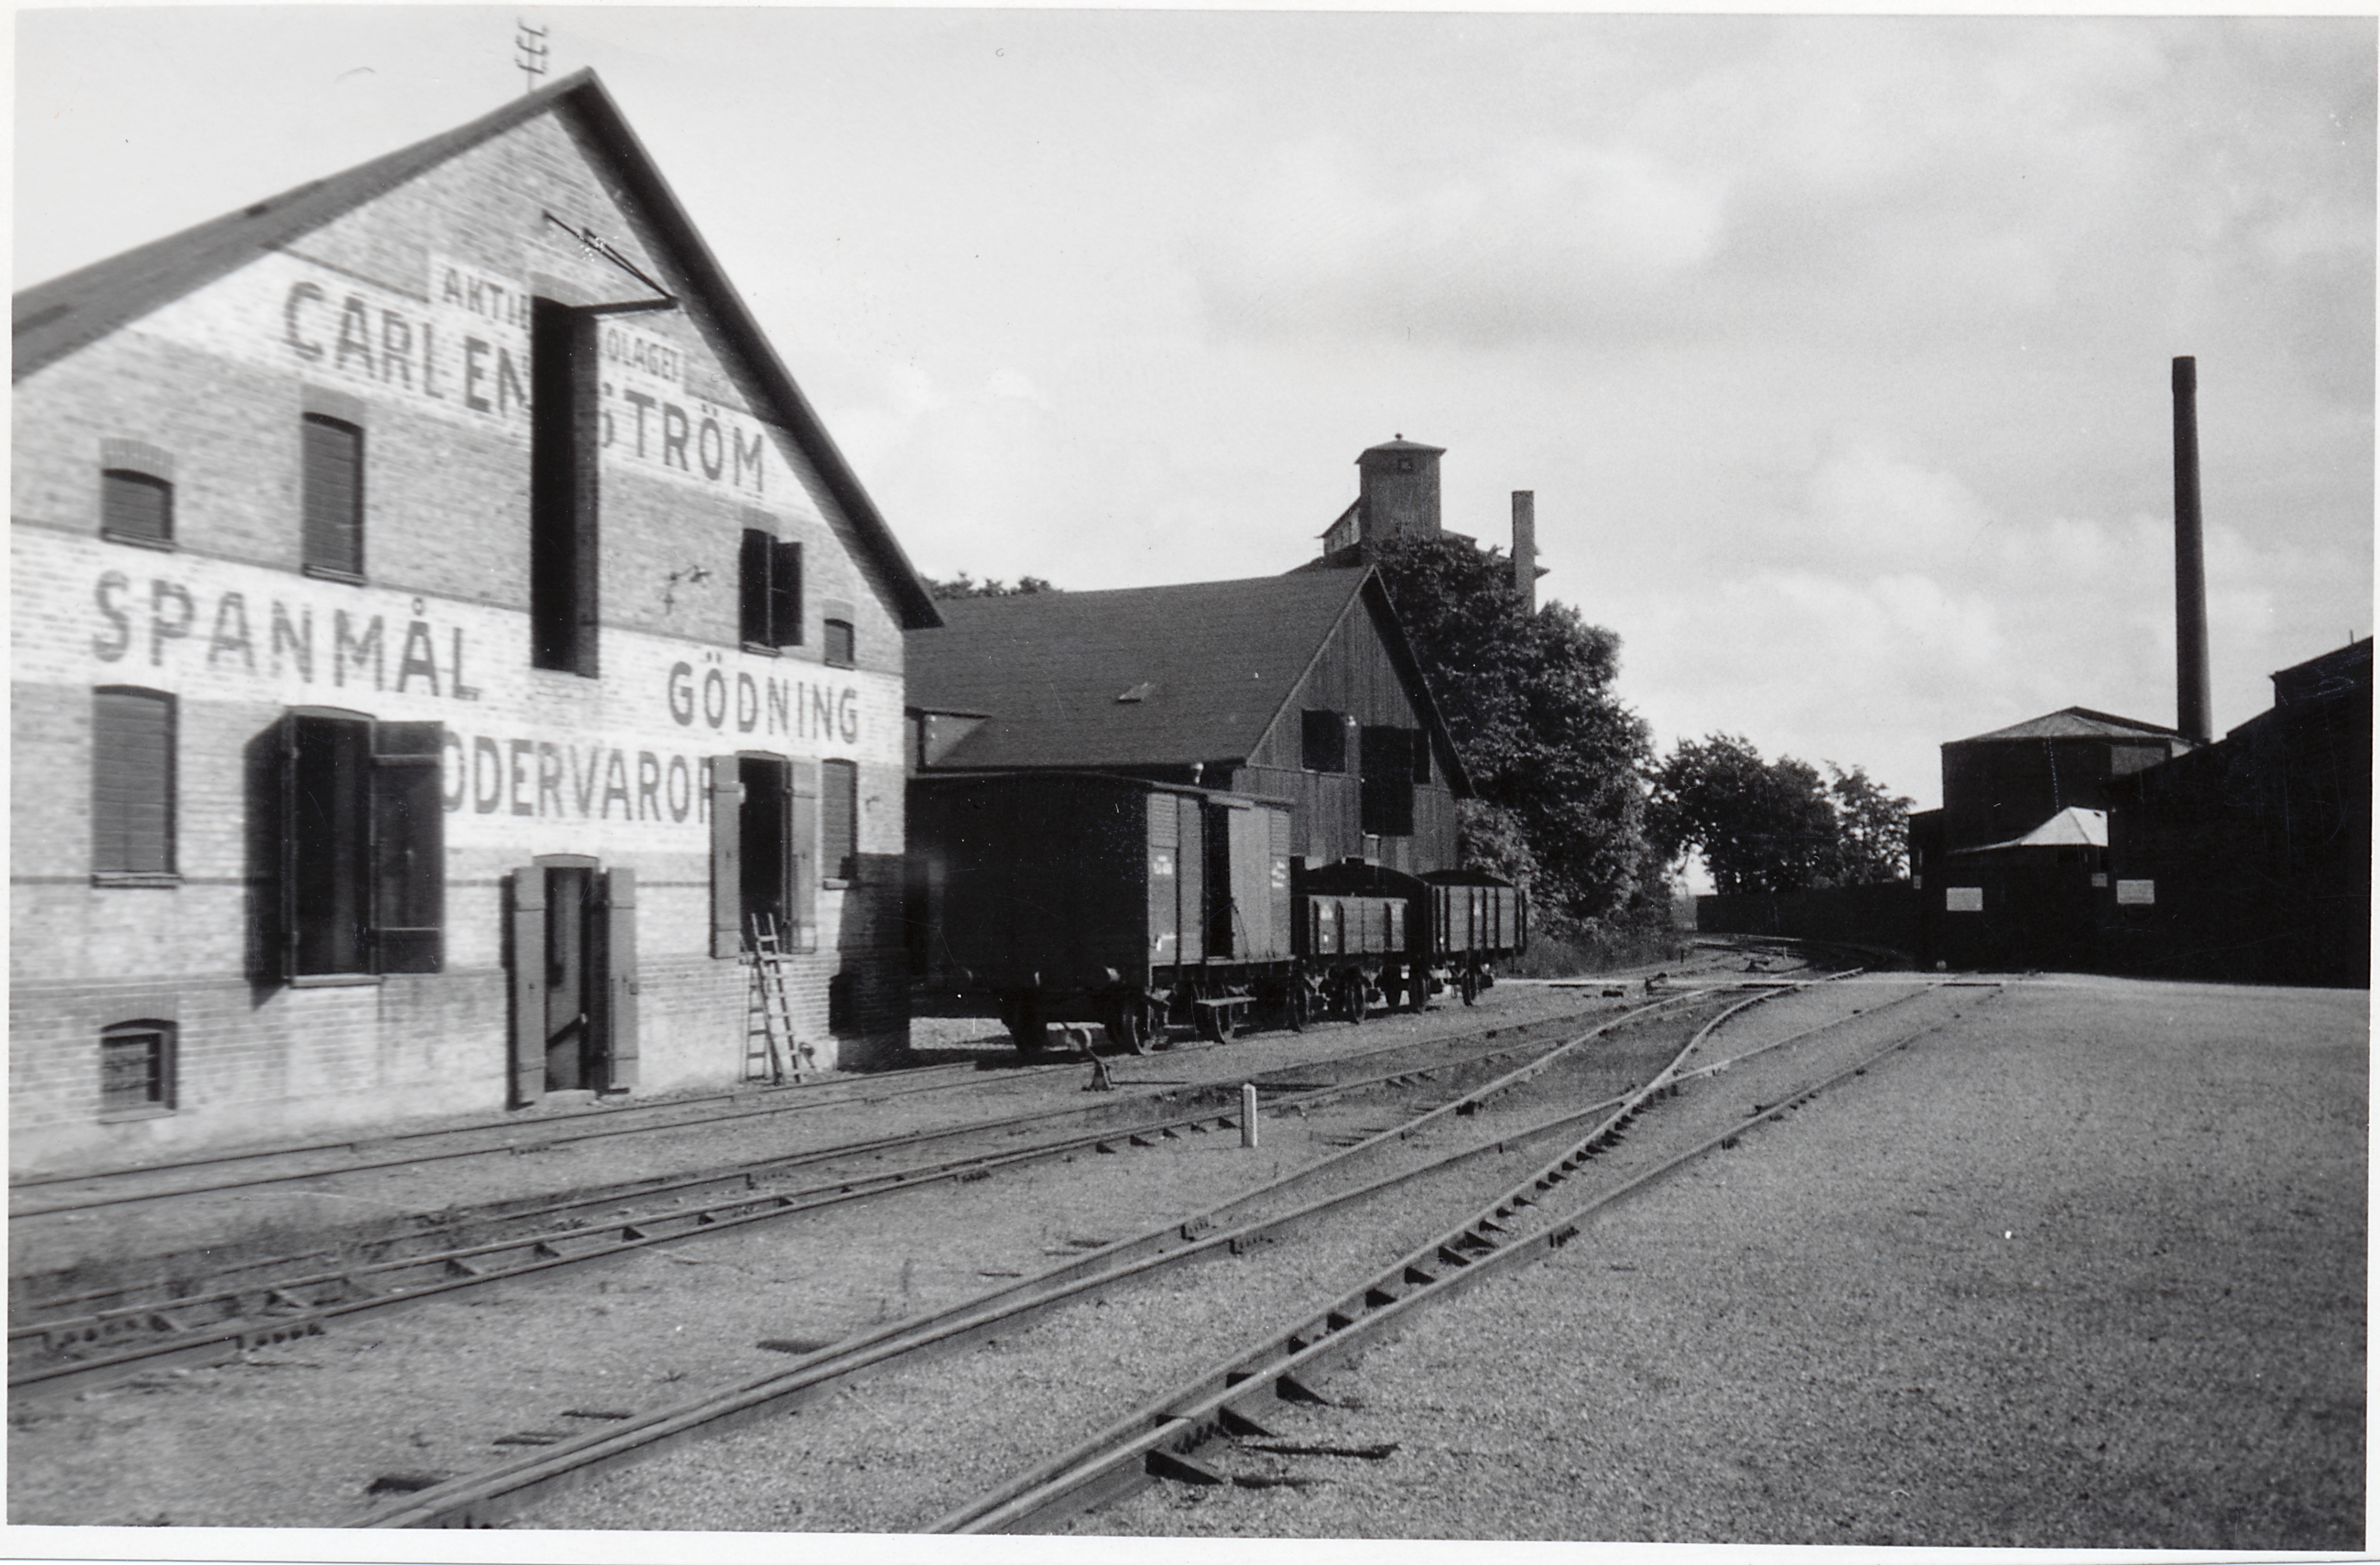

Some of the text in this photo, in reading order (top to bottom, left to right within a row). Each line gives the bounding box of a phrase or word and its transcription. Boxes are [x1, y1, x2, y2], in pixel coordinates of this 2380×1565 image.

[606, 328, 680, 384] OLAGET
[92, 569, 859, 744] SPANMÅL GÖDNING
[443, 730, 712, 824] ODERVARO
